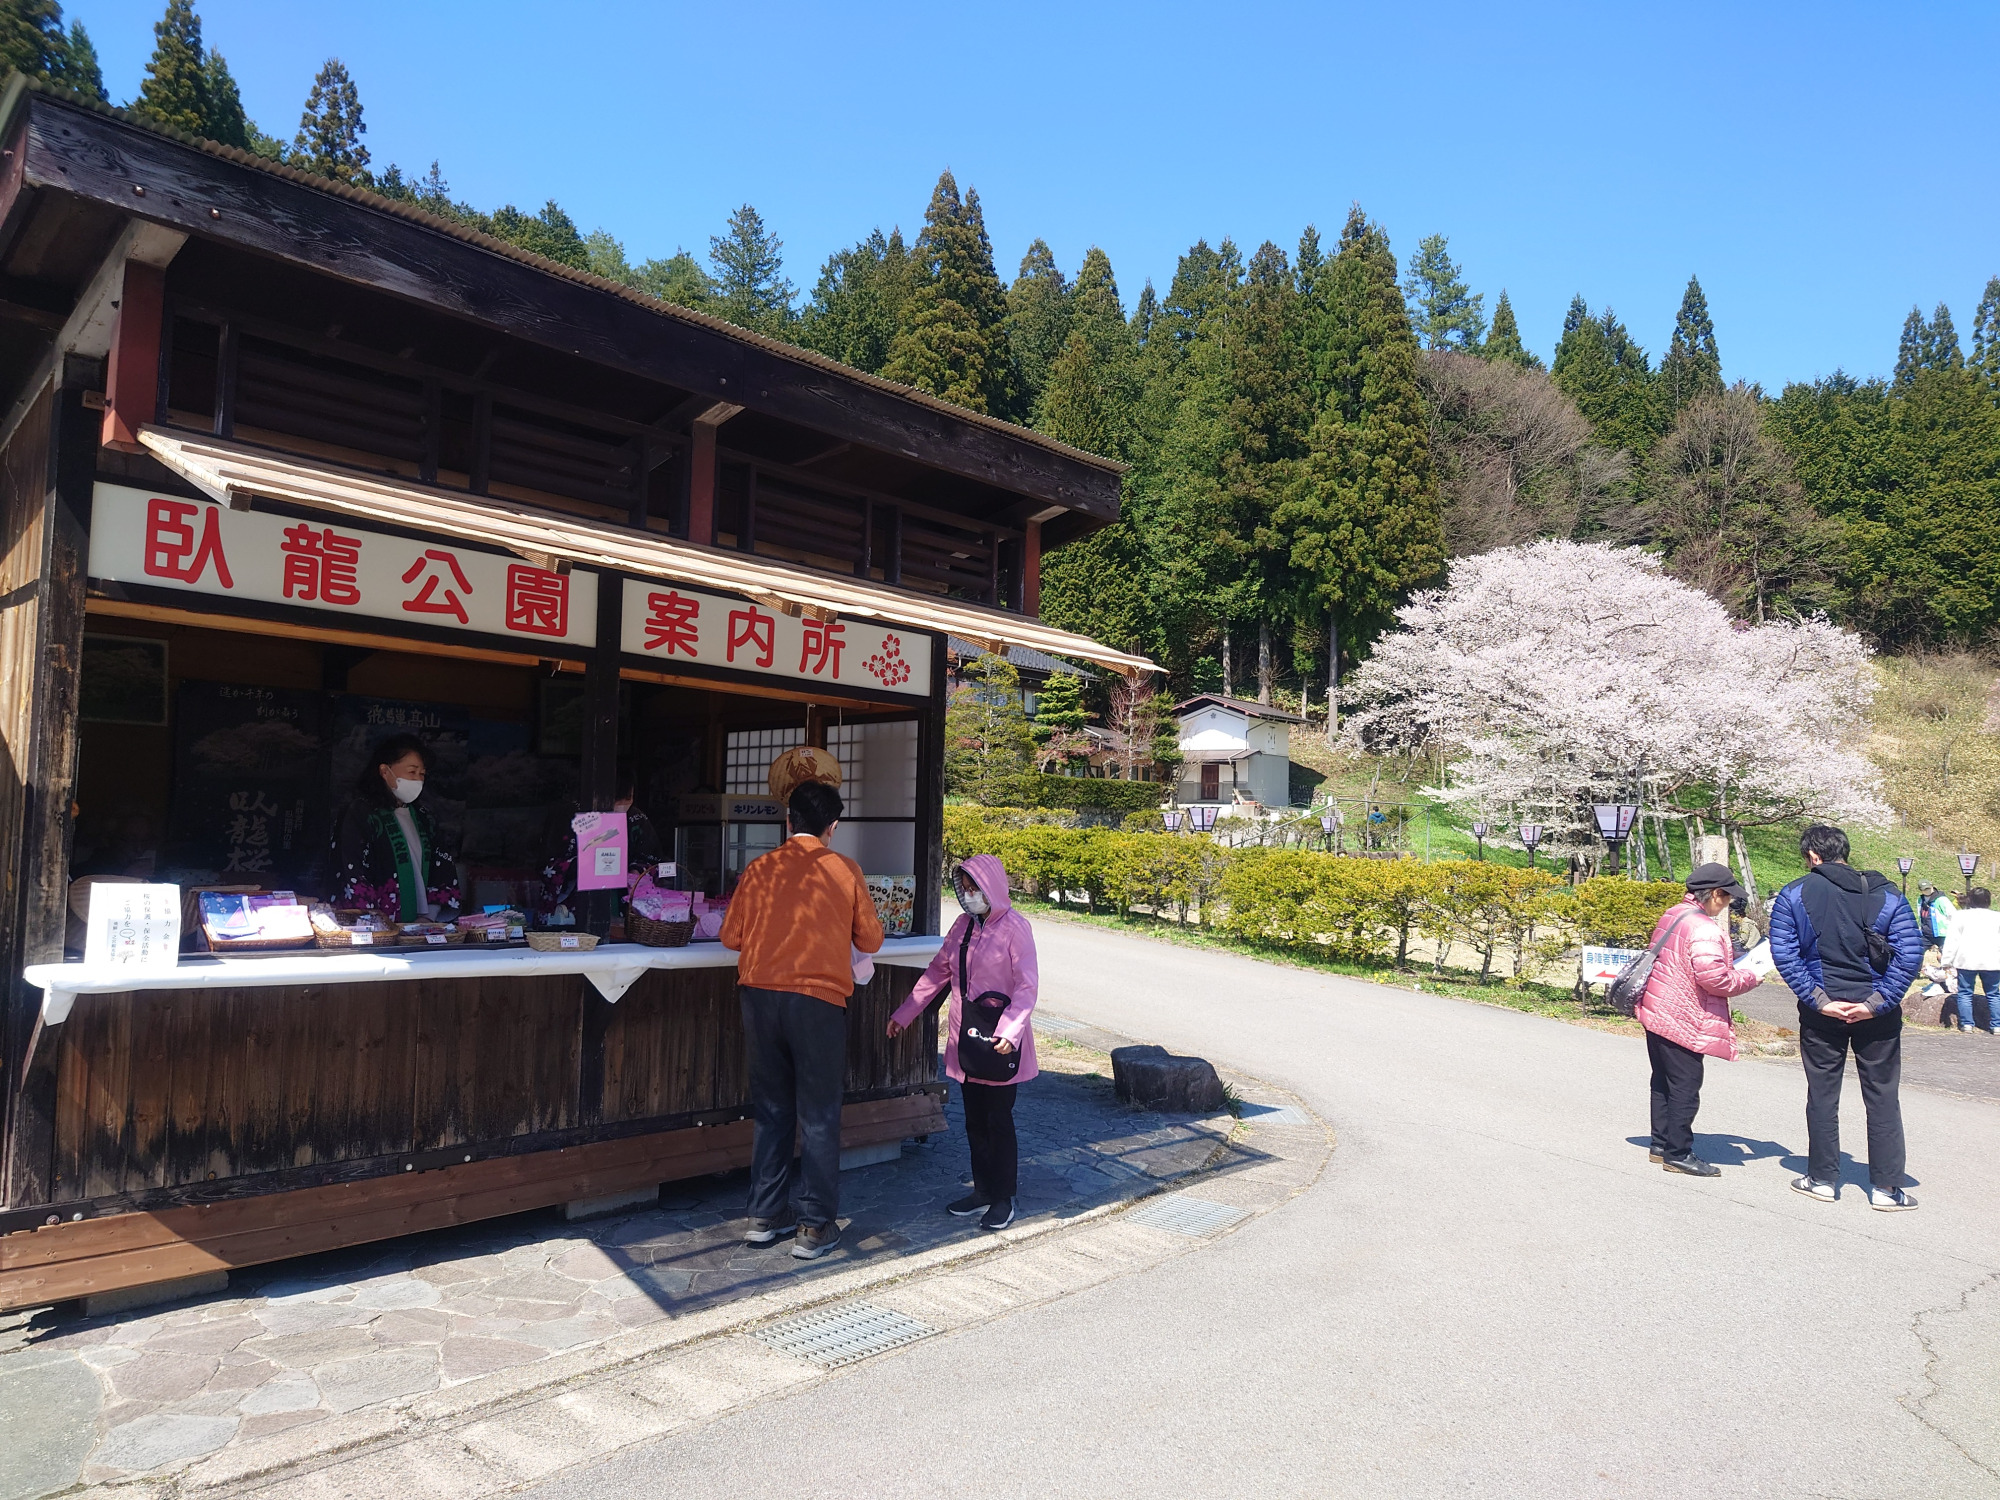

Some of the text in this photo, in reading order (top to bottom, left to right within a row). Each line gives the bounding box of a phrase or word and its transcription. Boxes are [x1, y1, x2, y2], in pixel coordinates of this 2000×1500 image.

[143, 498, 846, 679] 臥龍公園 案内所
[223, 790, 279, 874] 臥龍桜
[734, 804, 779, 816] キリンレモン
